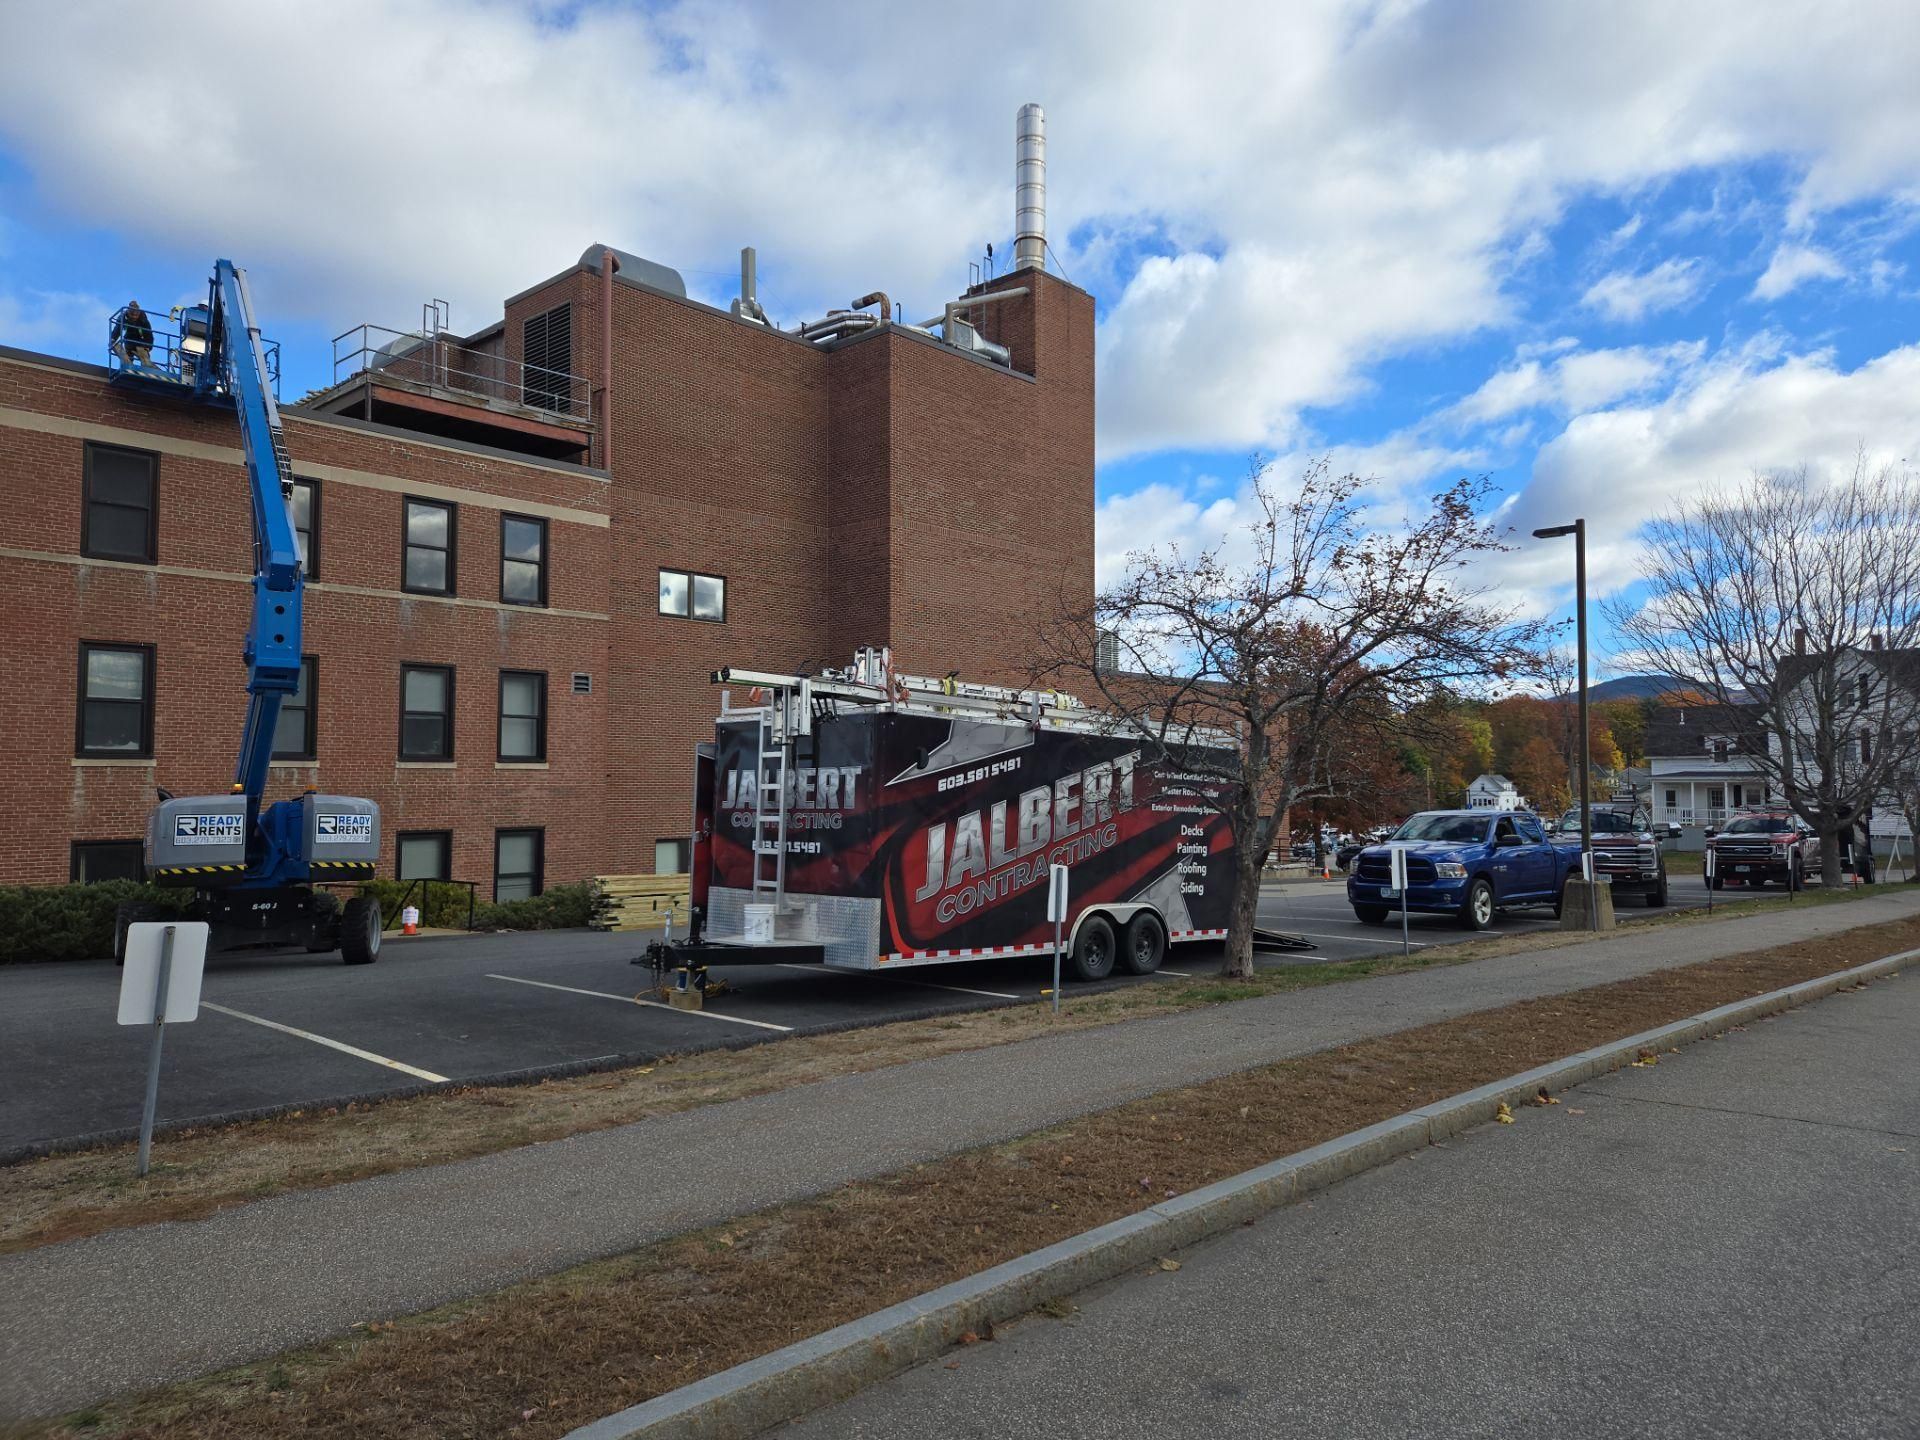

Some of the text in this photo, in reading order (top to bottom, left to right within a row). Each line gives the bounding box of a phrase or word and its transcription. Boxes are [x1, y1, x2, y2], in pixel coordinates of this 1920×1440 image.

[722, 766, 862, 810] JALBERT
[200, 816, 242, 826] READY
[338, 816, 371, 825] READY
[915, 749, 1142, 903] JALBERT
[199, 826, 241, 836] RENTS
[338, 826, 370, 835] RENTS
[1181, 824, 1204, 836] Decks
[1177, 842, 1207, 857] Painting
[936, 823, 1117, 924] CONTRACTING
[1177, 862, 1207, 876] Roofing
[1180, 881, 1204, 896] Siding
